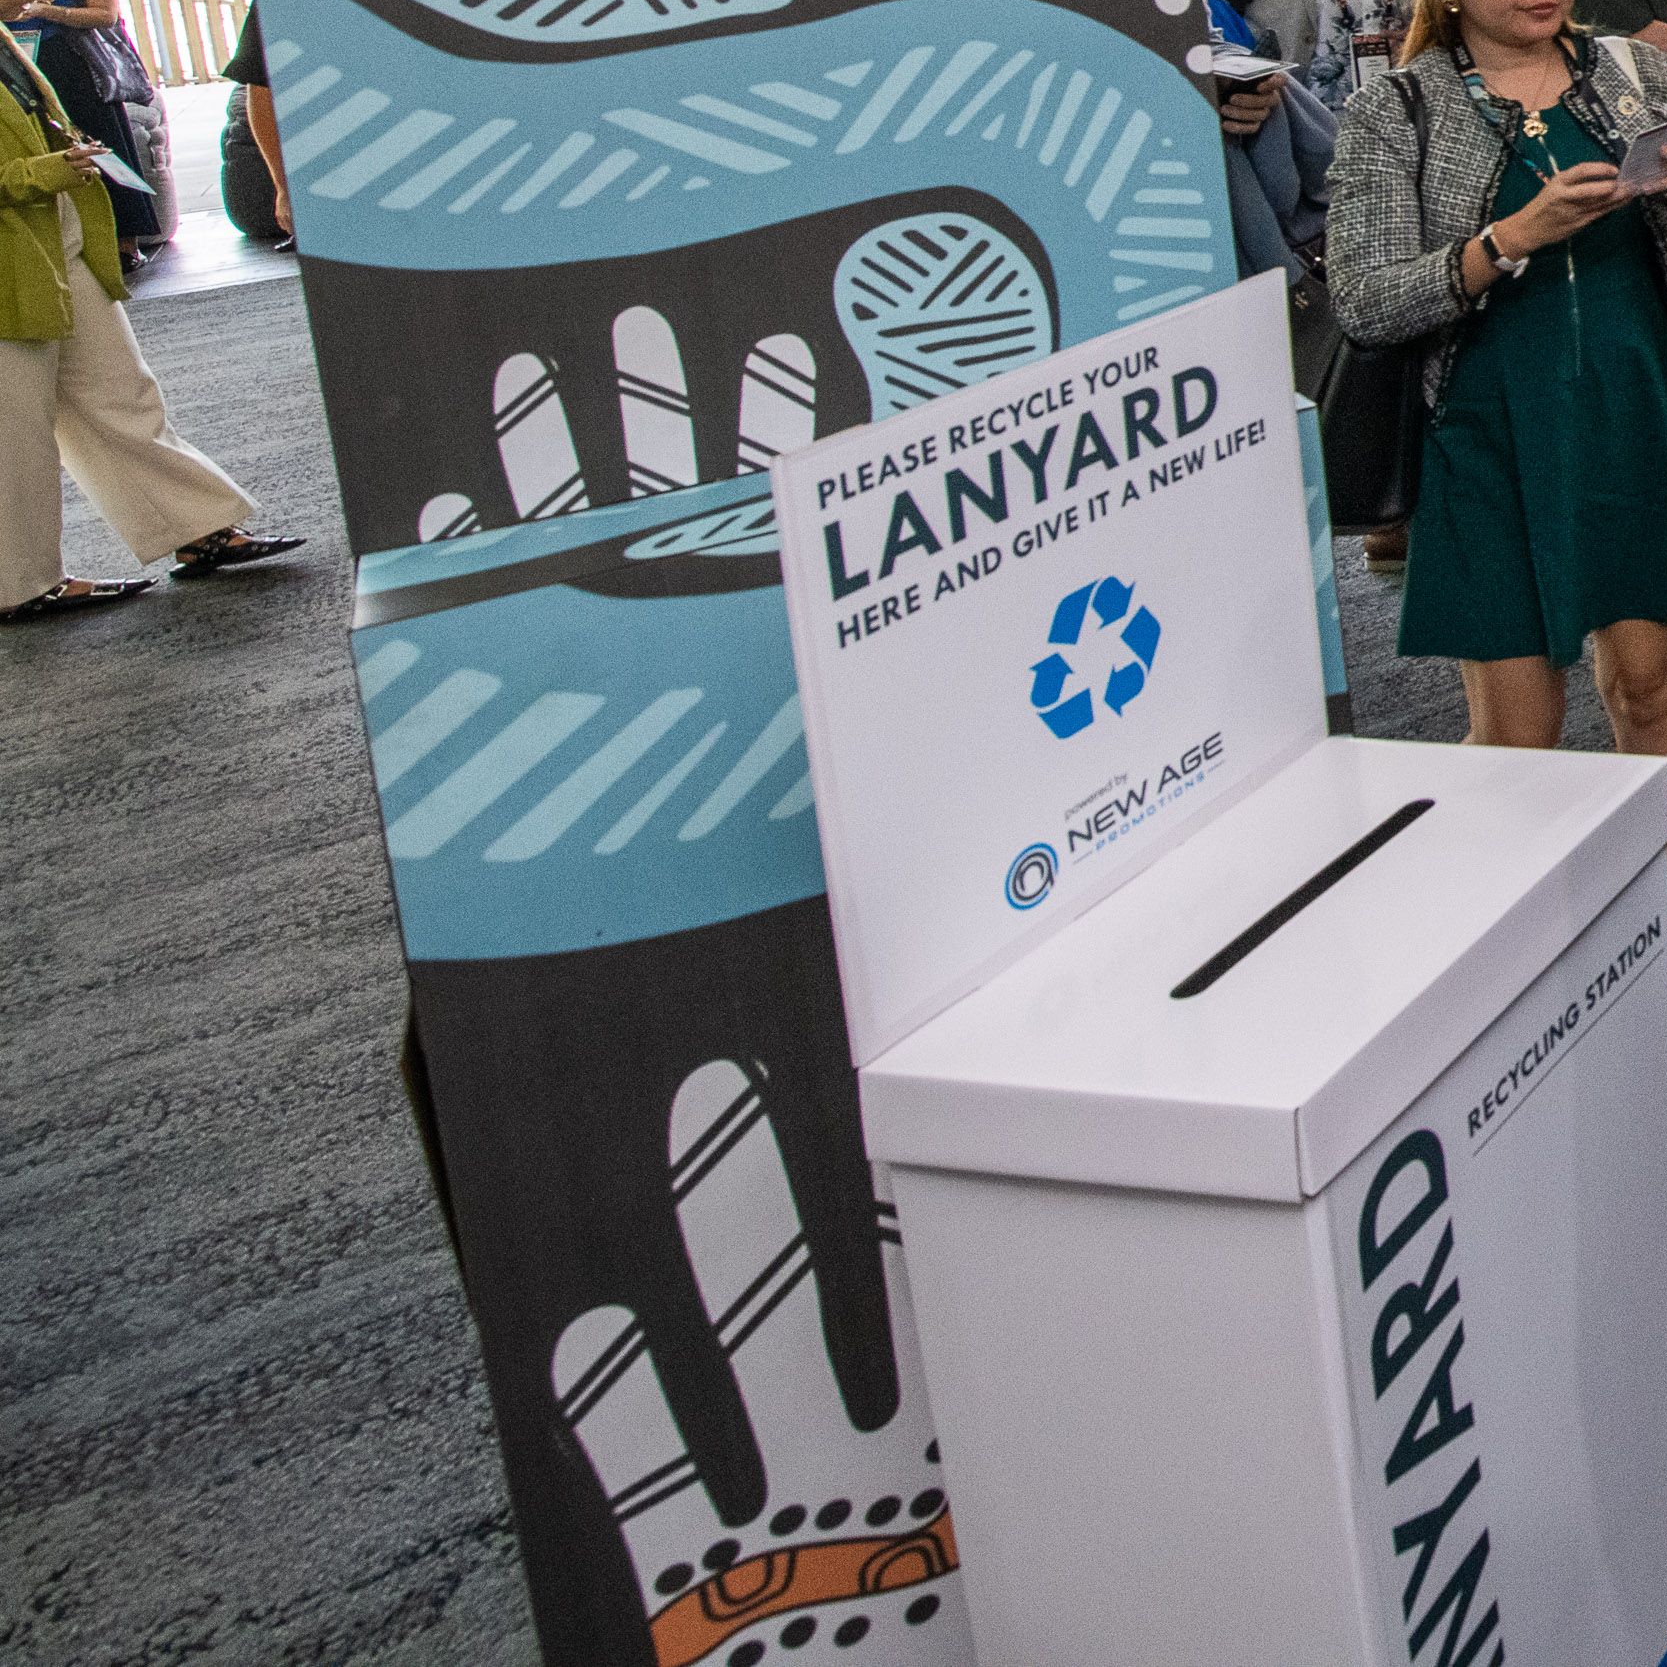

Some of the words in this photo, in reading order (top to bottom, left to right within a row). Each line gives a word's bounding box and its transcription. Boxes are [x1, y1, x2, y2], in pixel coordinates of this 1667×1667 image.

[816, 435, 939, 511] PLEASE
[948, 379, 1075, 455] RECYCLE
[1083, 345, 1161, 393] YOUR
[822, 364, 1221, 603] LANYARD
[835, 582, 921, 650] HERE
[932, 547, 1002, 602] AND
[1012, 505, 1080, 558] GIVE
[1087, 491, 1111, 524] IT
[1120, 479, 1141, 508] A
[1148, 444, 1206, 494] NEW
[1213, 417, 1268, 463] LIFE!
[1064, 778, 1113, 823] powered
[1113, 772, 1129, 790] by
[1067, 778, 1148, 854] NEW
[1156, 731, 1224, 794] AGE
[1094, 770, 1206, 851] PROMOTIONS
[1467, 1001, 1580, 1138] RECYCLING
[1585, 915, 1662, 1011] STATION
[1357, 1127, 1505, 1667] NYARD
